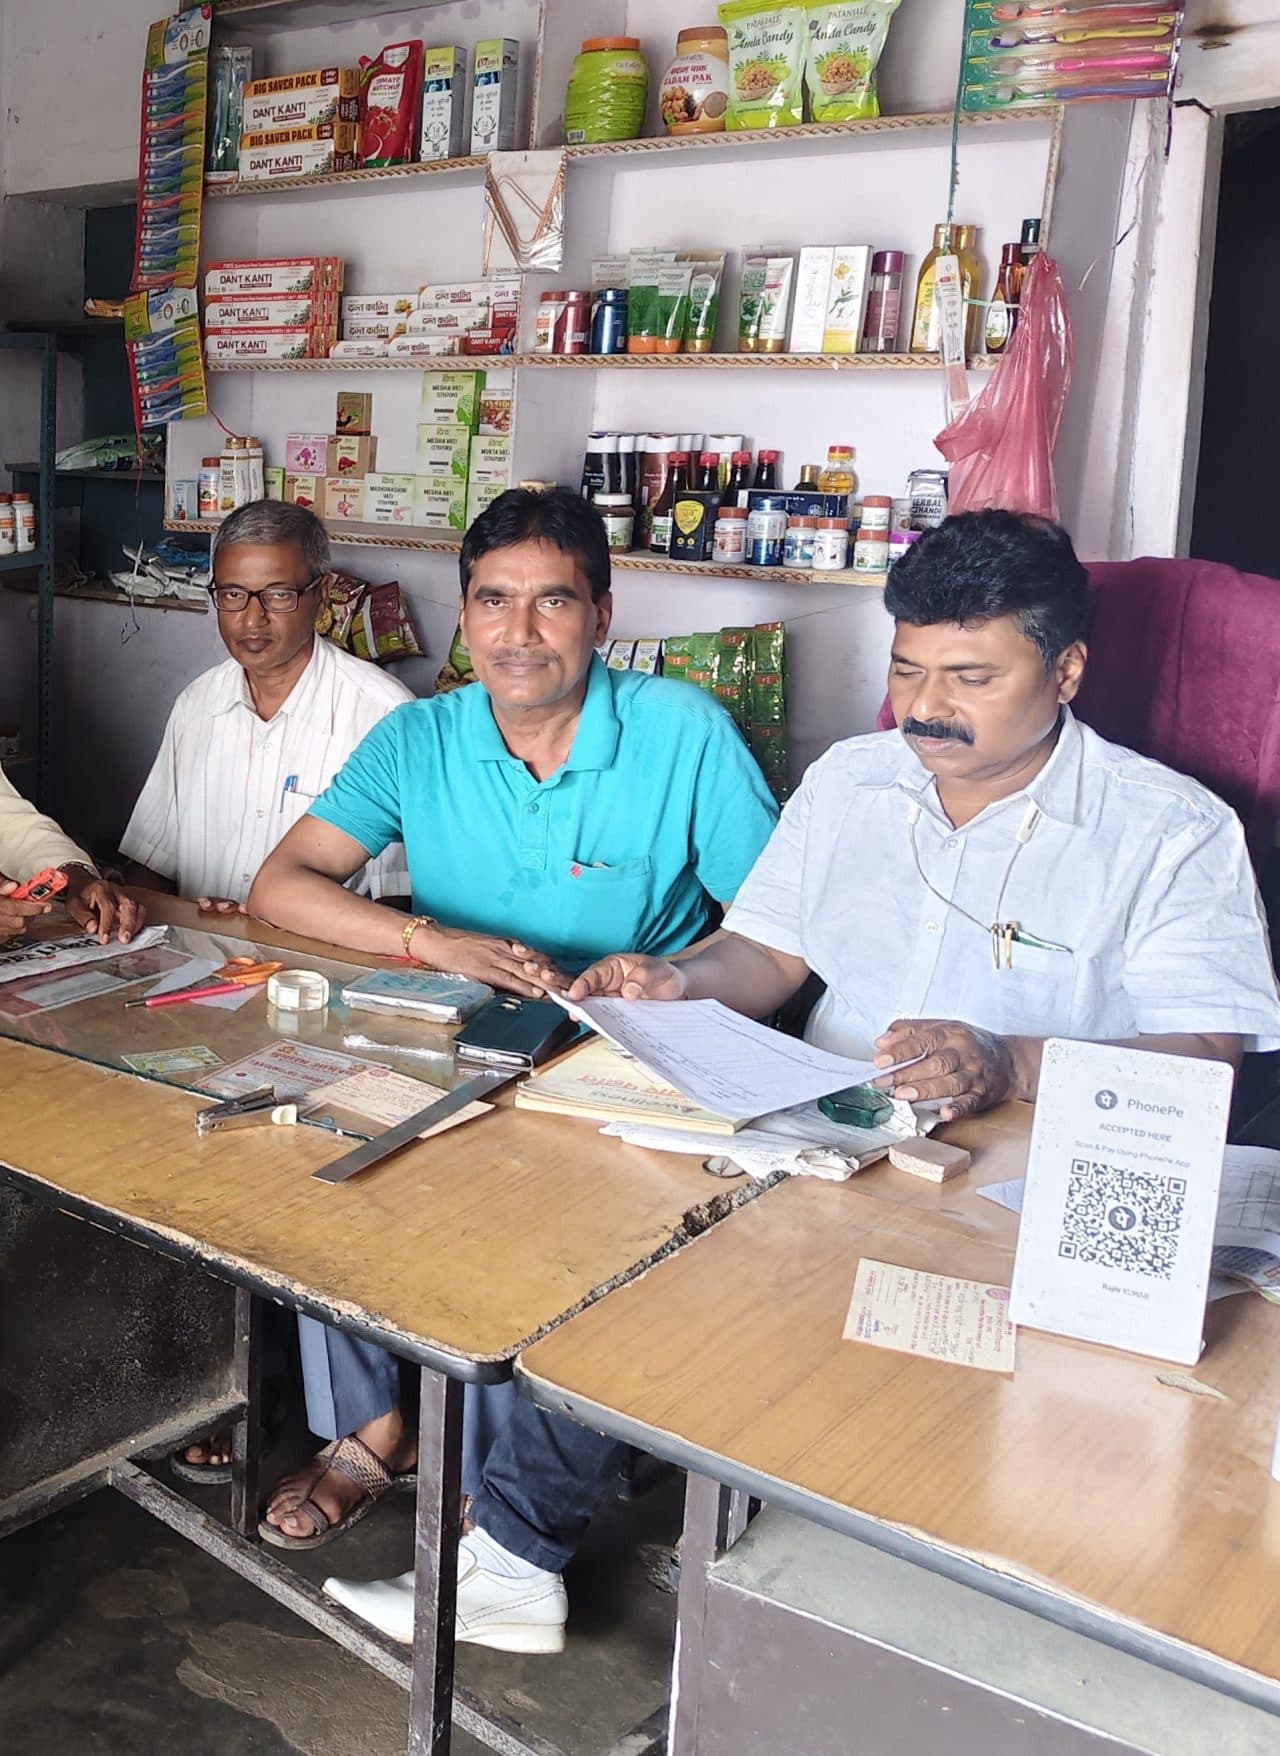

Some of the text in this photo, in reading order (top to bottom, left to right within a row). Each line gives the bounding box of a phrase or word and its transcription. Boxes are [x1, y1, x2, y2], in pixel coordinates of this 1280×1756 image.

[843, 20, 877, 38] Candy
[732, 29, 794, 50] Amla Candy
[253, 80, 267, 96] BIG
[268, 78, 294, 93] SAVER
[296, 74, 317, 91] PACK
[692, 74, 712, 82] PAK
[253, 102, 306, 119] DANT KANTI
[249, 128, 313, 147] BIG SAVER PACK
[250, 155, 302, 170] DANT KANTI
[220, 273, 272, 285] DANT KANTI
[219, 307, 269, 318] DANT KANTI
[217, 340, 267, 350] DANT KANTI
[1127, 1098, 1184, 1118] PhonePe
[1099, 1122, 1172, 1142] ACCEPTED HERE
[1075, 1140, 1093, 1149] Scan
